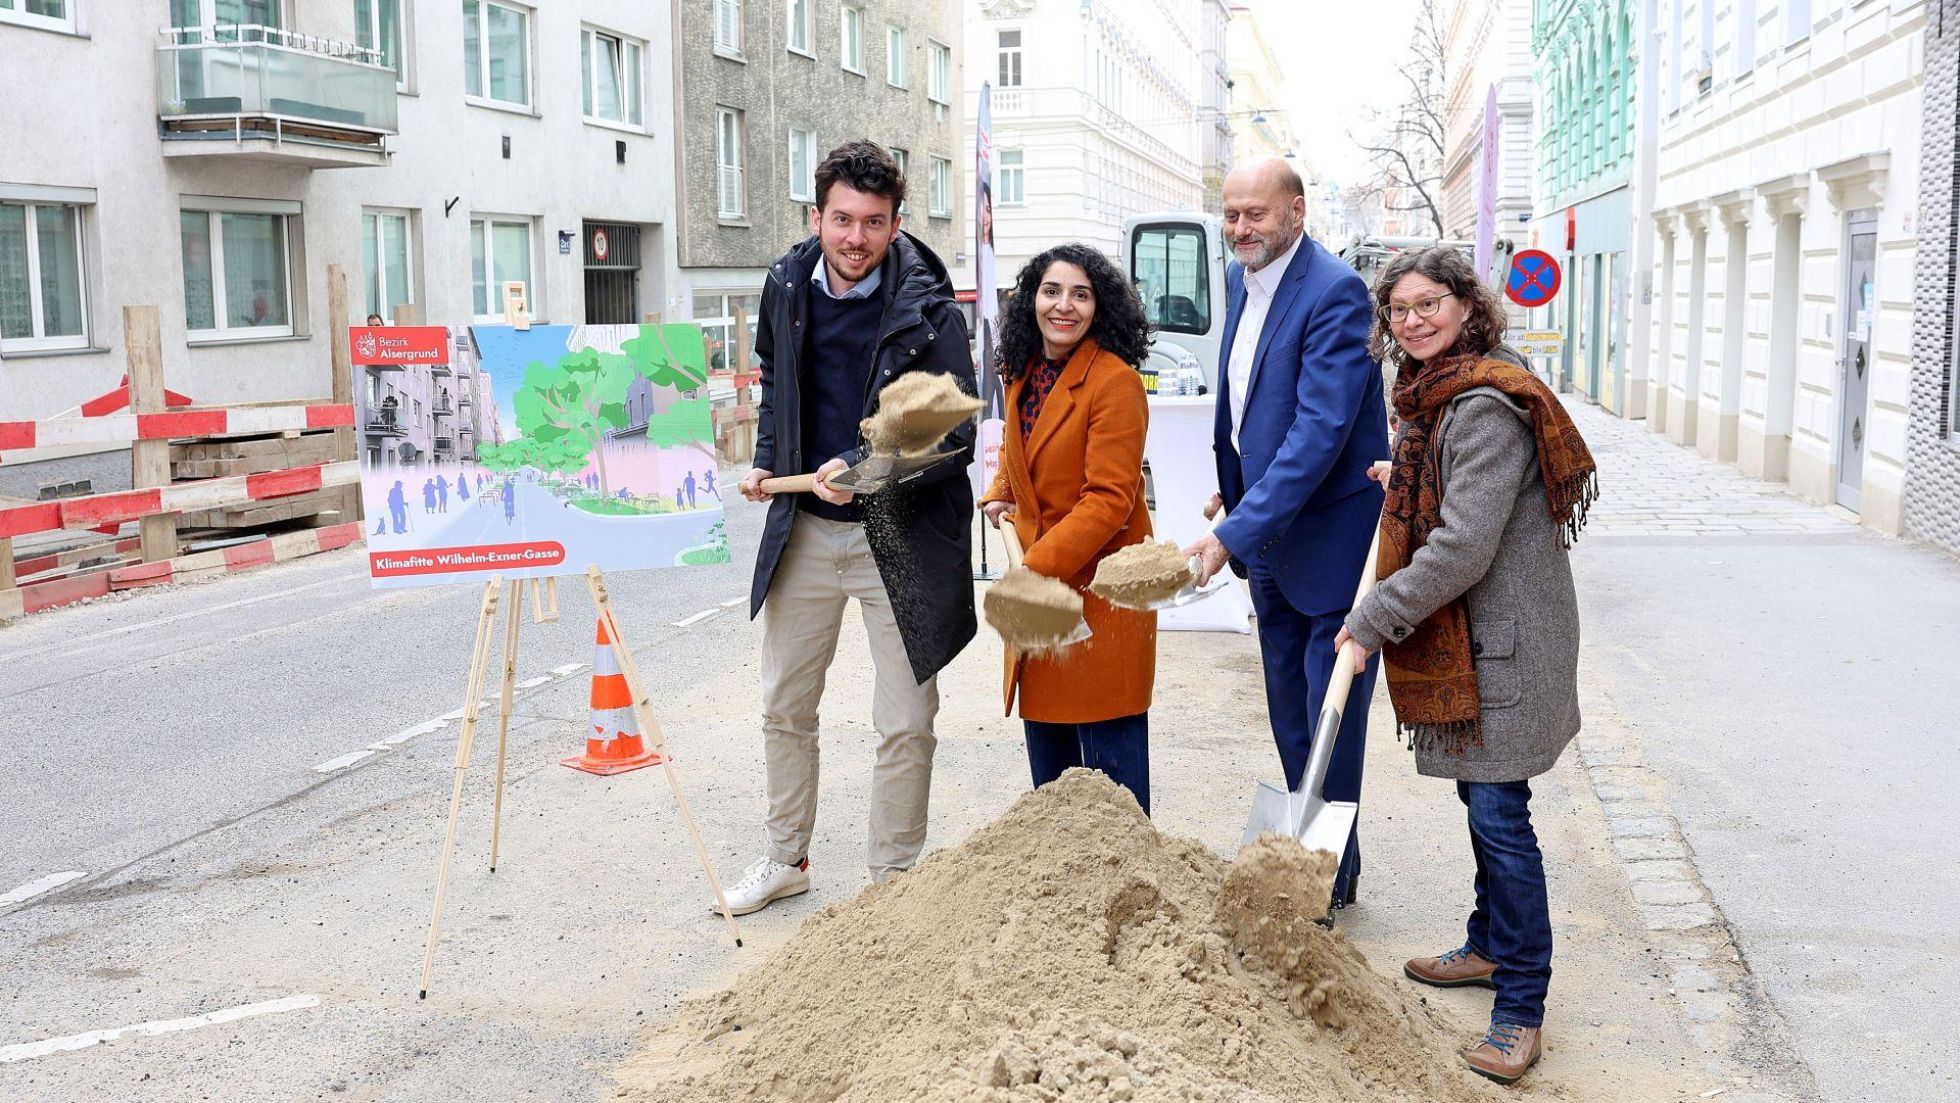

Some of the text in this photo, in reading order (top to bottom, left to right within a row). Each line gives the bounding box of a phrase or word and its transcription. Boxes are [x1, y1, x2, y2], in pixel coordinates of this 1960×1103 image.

[379, 337, 409, 346] Bezirk
[380, 347, 438, 361] Alsergrund
[376, 549, 560, 570] Klimafitte Wilhelm-Exner-Gasse
